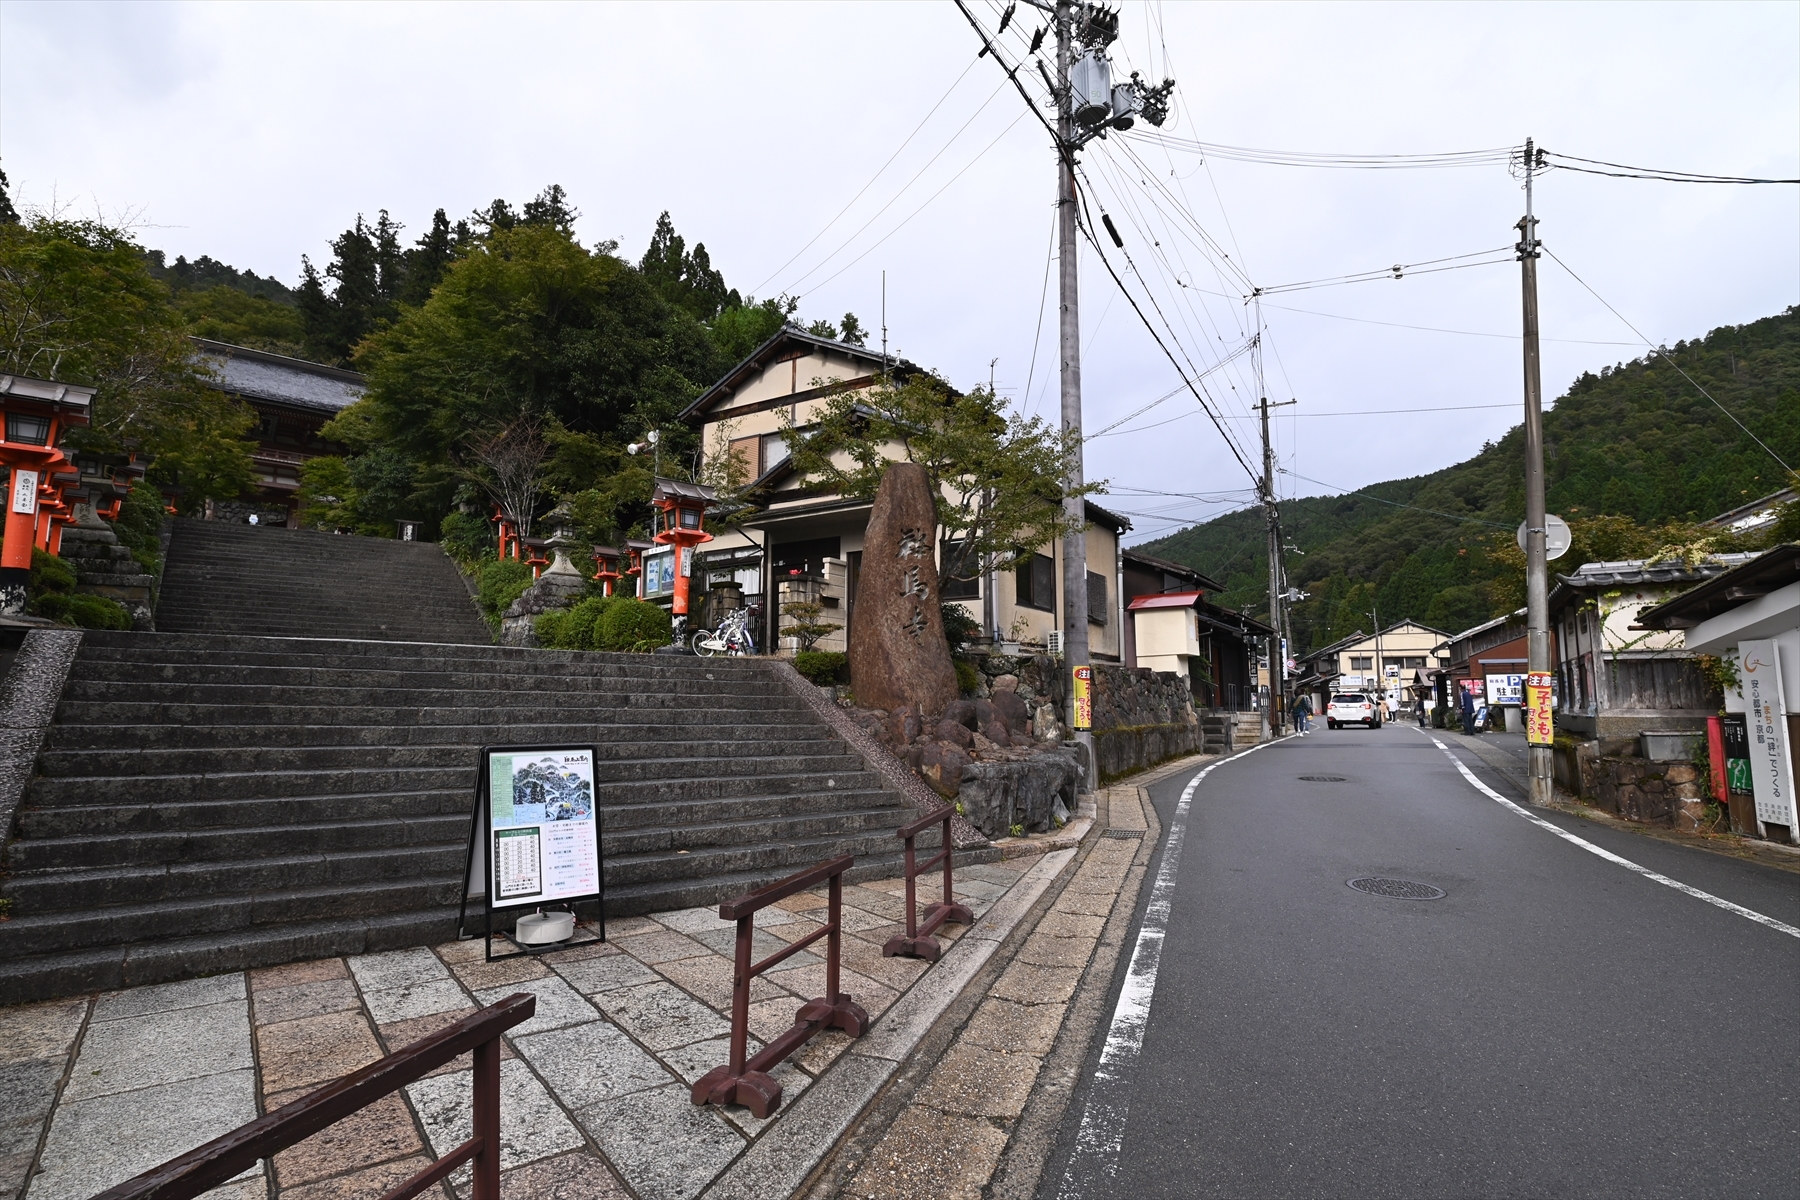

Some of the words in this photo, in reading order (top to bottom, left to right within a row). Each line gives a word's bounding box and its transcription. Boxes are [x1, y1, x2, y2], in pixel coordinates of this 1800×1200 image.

[1091, 90, 1102, 98] 50
[895, 526, 933, 648] 鞍馬寺
[1510, 676, 1519, 686] P
[1528, 675, 1552, 687] 注意
[1751, 679, 1766, 744] 安心都市・京都
